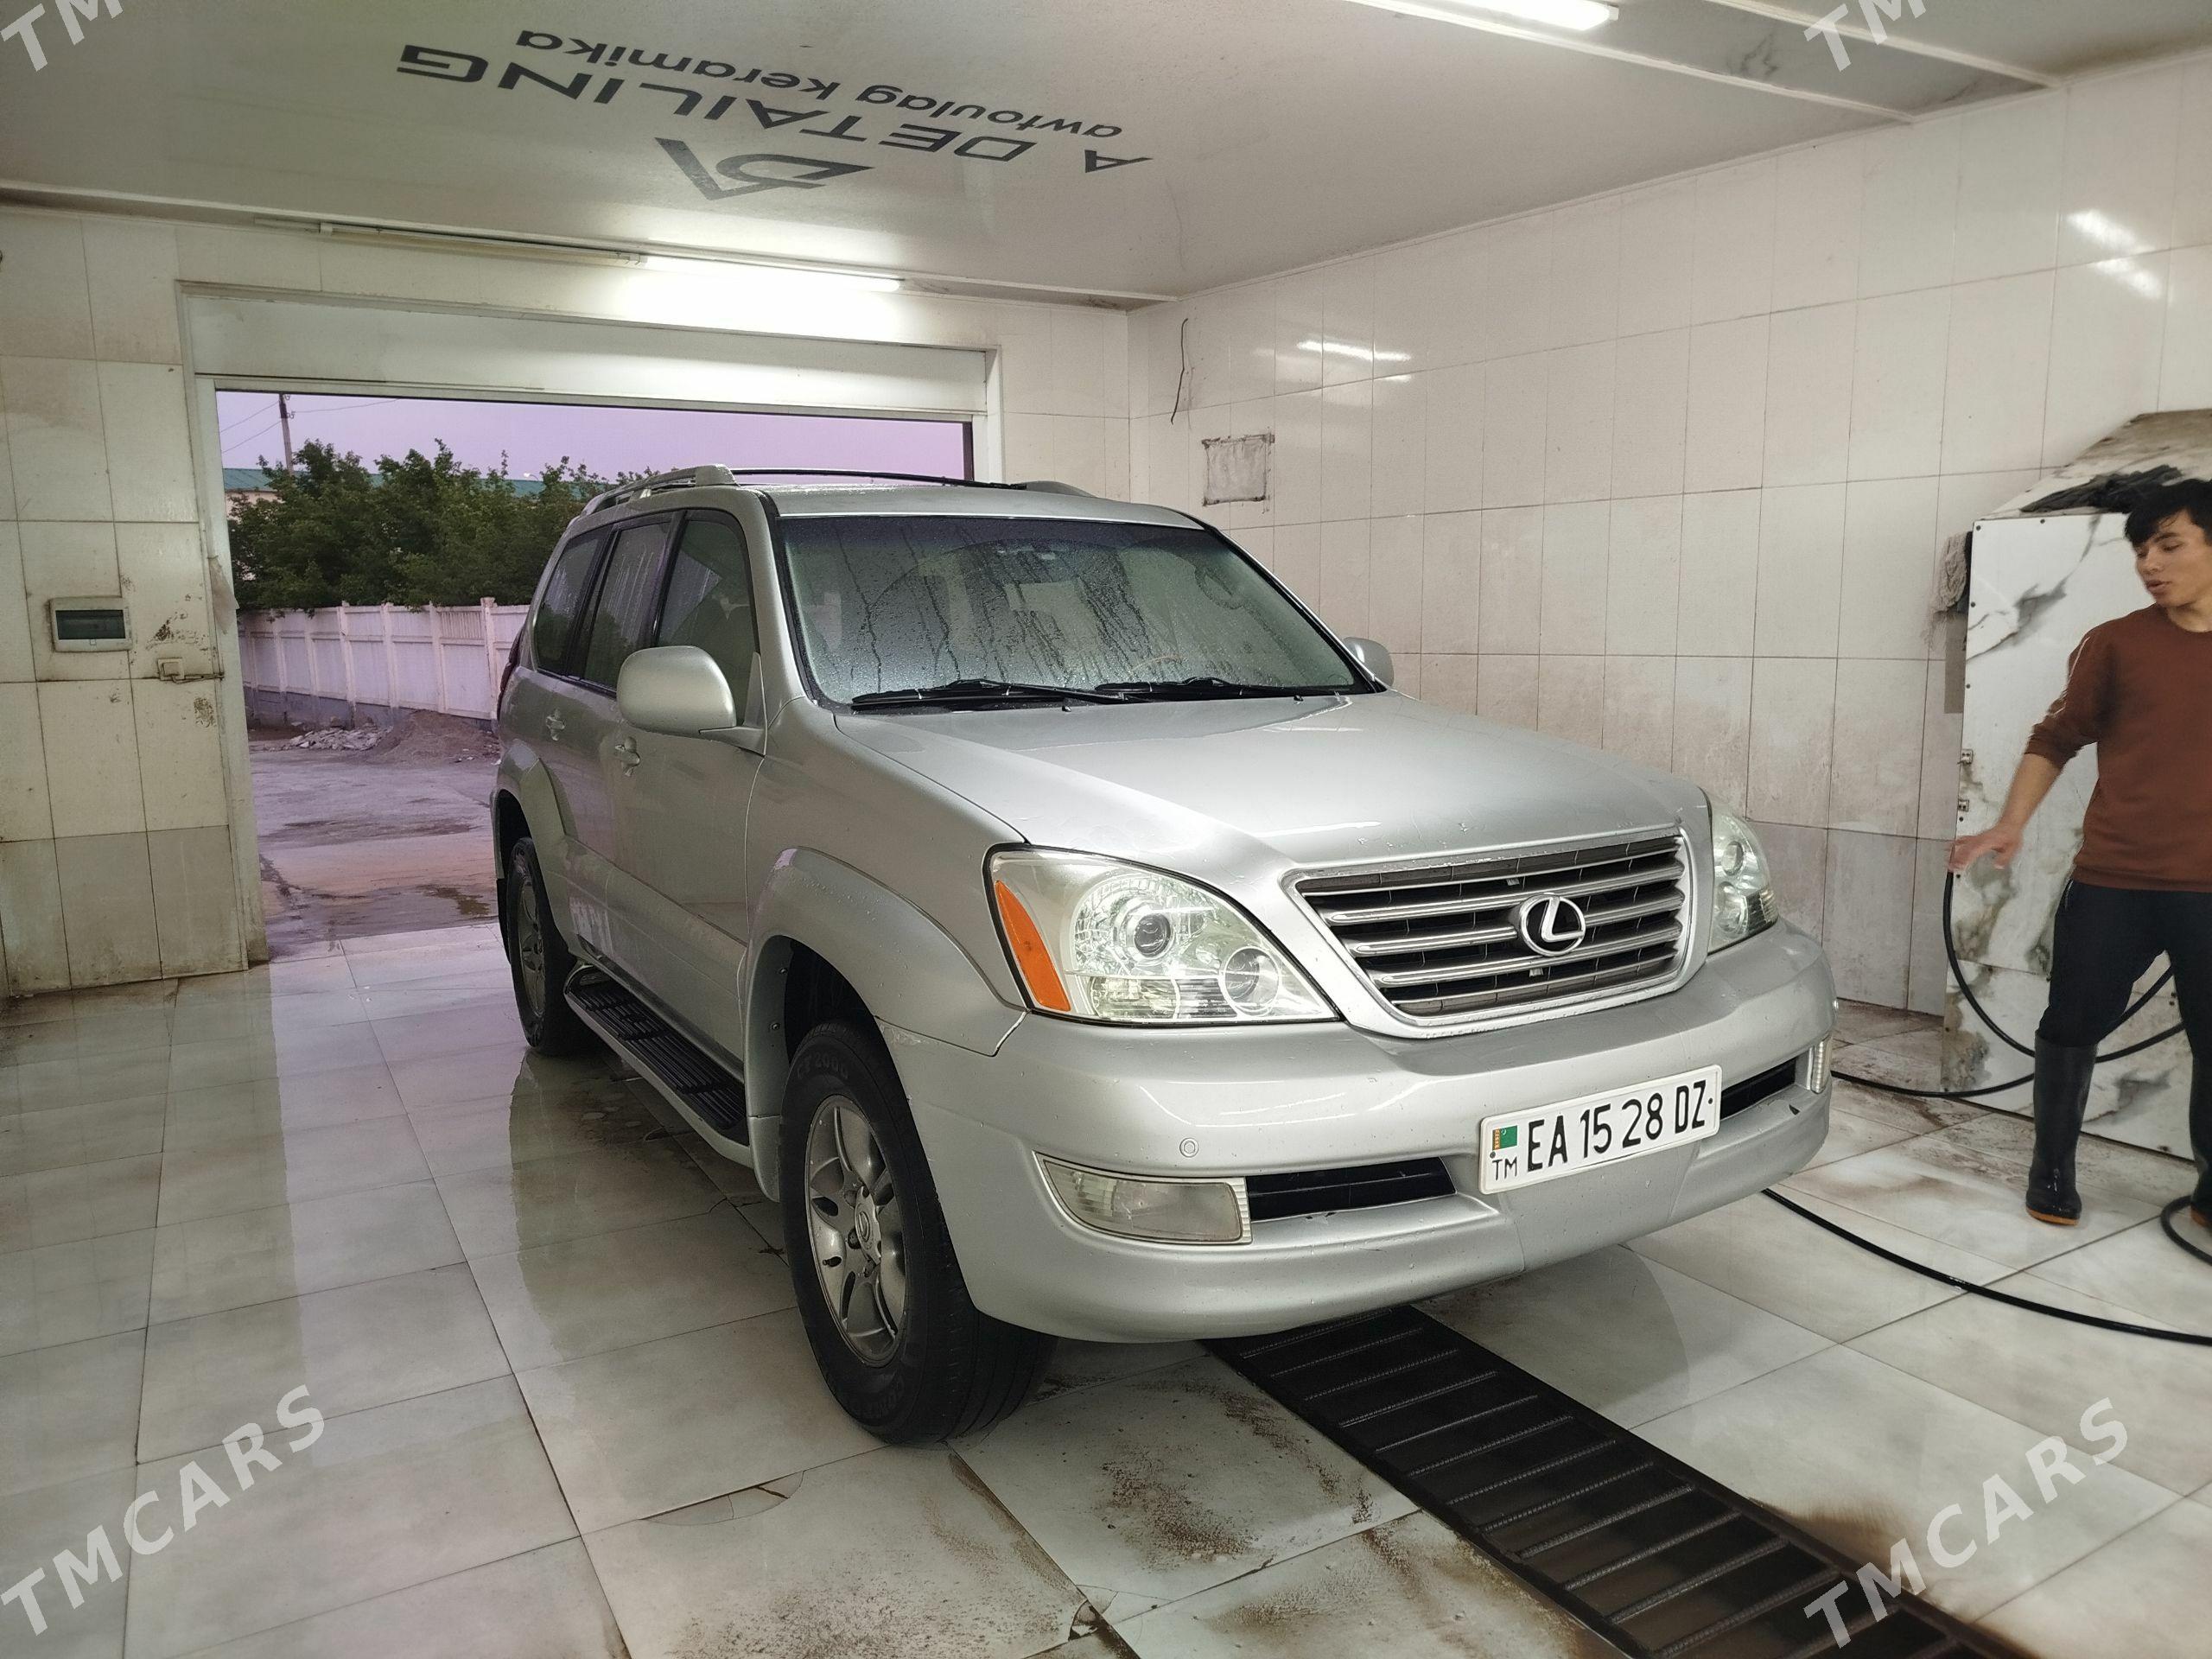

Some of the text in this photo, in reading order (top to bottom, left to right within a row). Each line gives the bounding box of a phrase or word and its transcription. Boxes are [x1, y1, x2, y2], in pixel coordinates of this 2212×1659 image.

[397, 45, 1154, 173] A DETAILING
[516, 30, 1122, 138] awtoulag keramika
[1491, 1156, 1518, 1181] TM
[1527, 1079, 1707, 1173] EA 15 28 DZ
